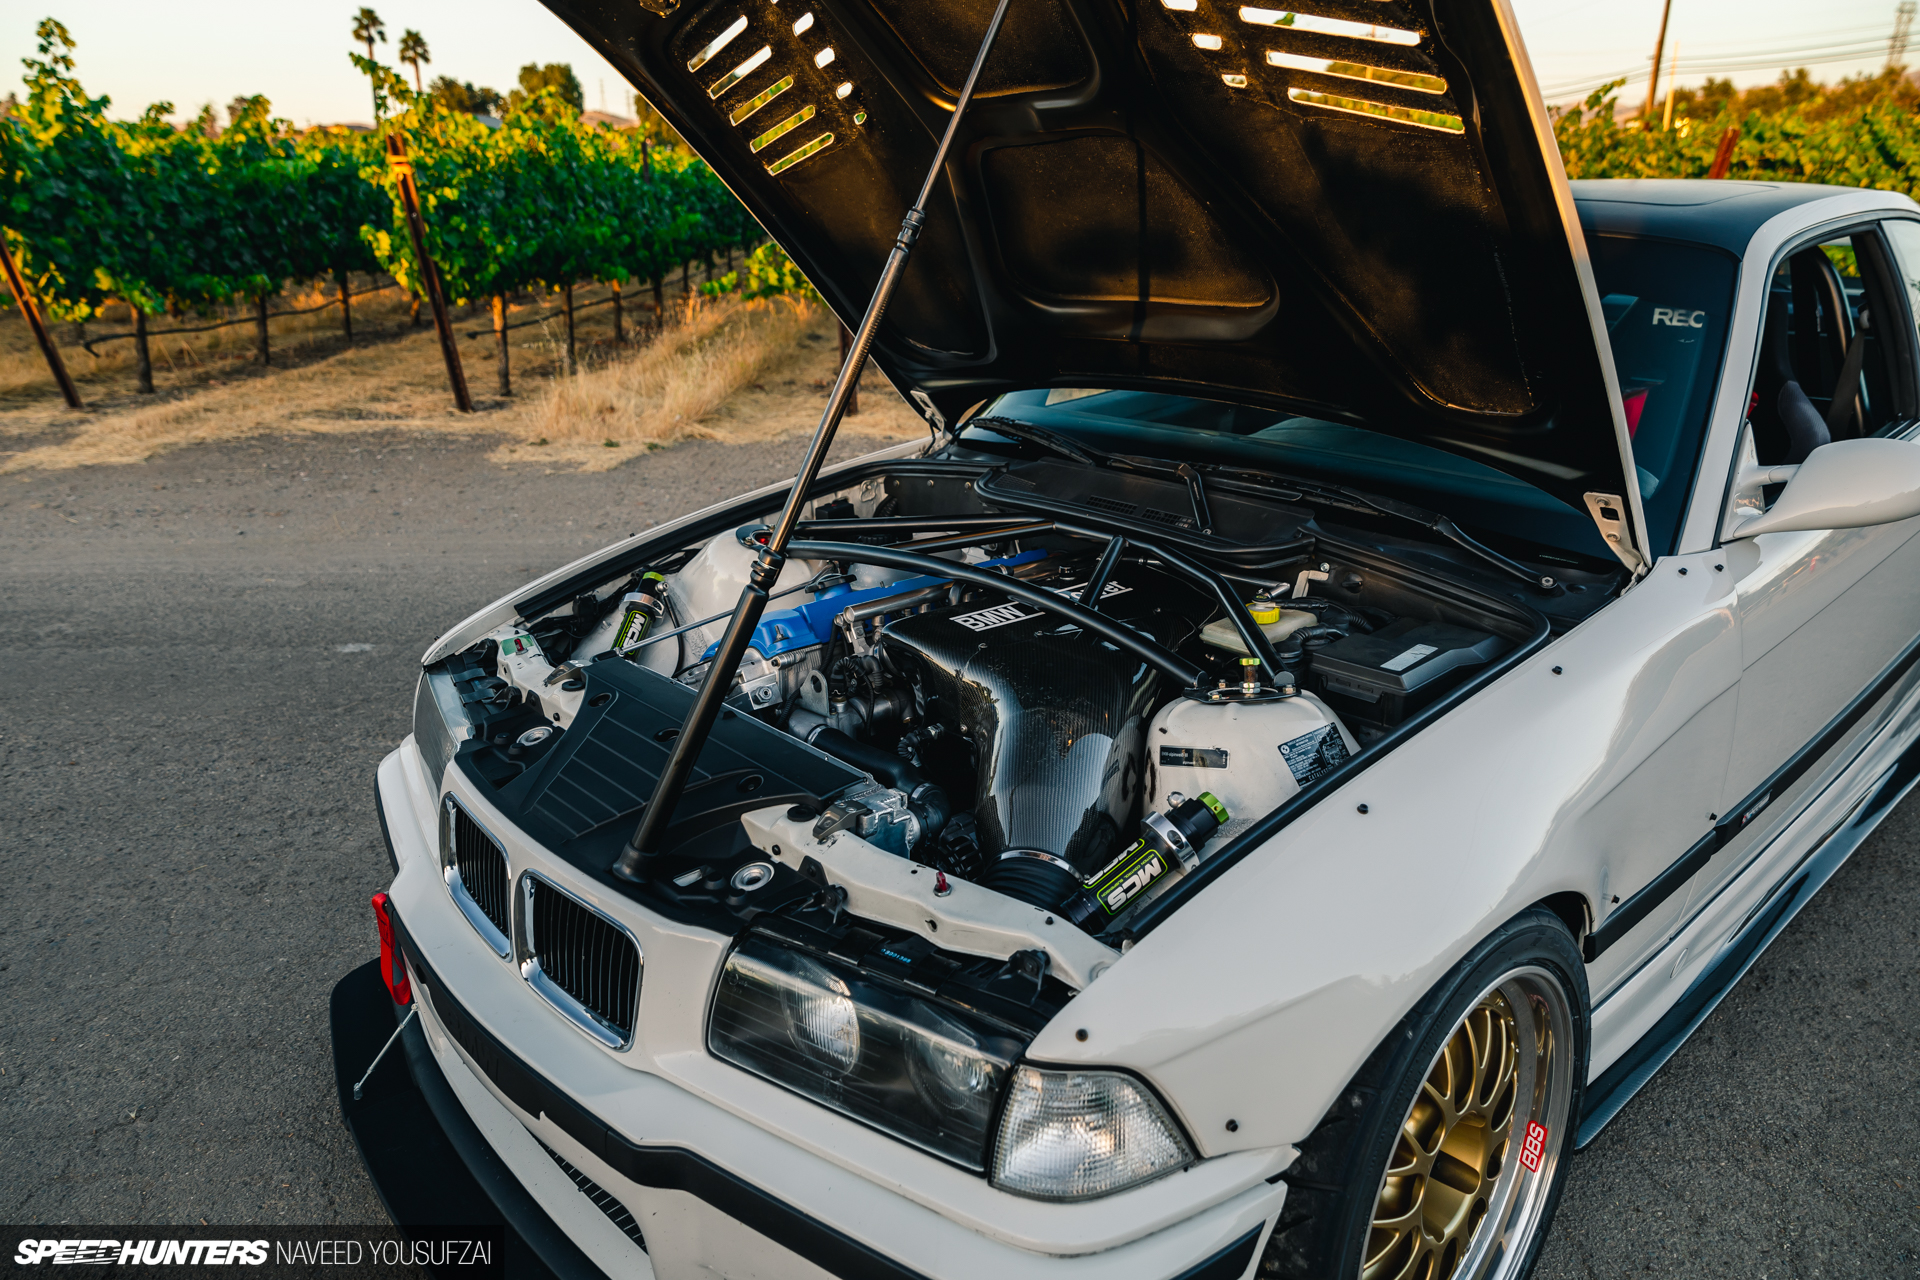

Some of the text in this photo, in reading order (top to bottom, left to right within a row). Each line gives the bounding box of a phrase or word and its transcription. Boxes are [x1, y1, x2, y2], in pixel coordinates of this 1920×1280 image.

[957, 604, 1027, 630] BMW
[1107, 857, 1162, 911] MCS
[1521, 1122, 1545, 1171] BBS
